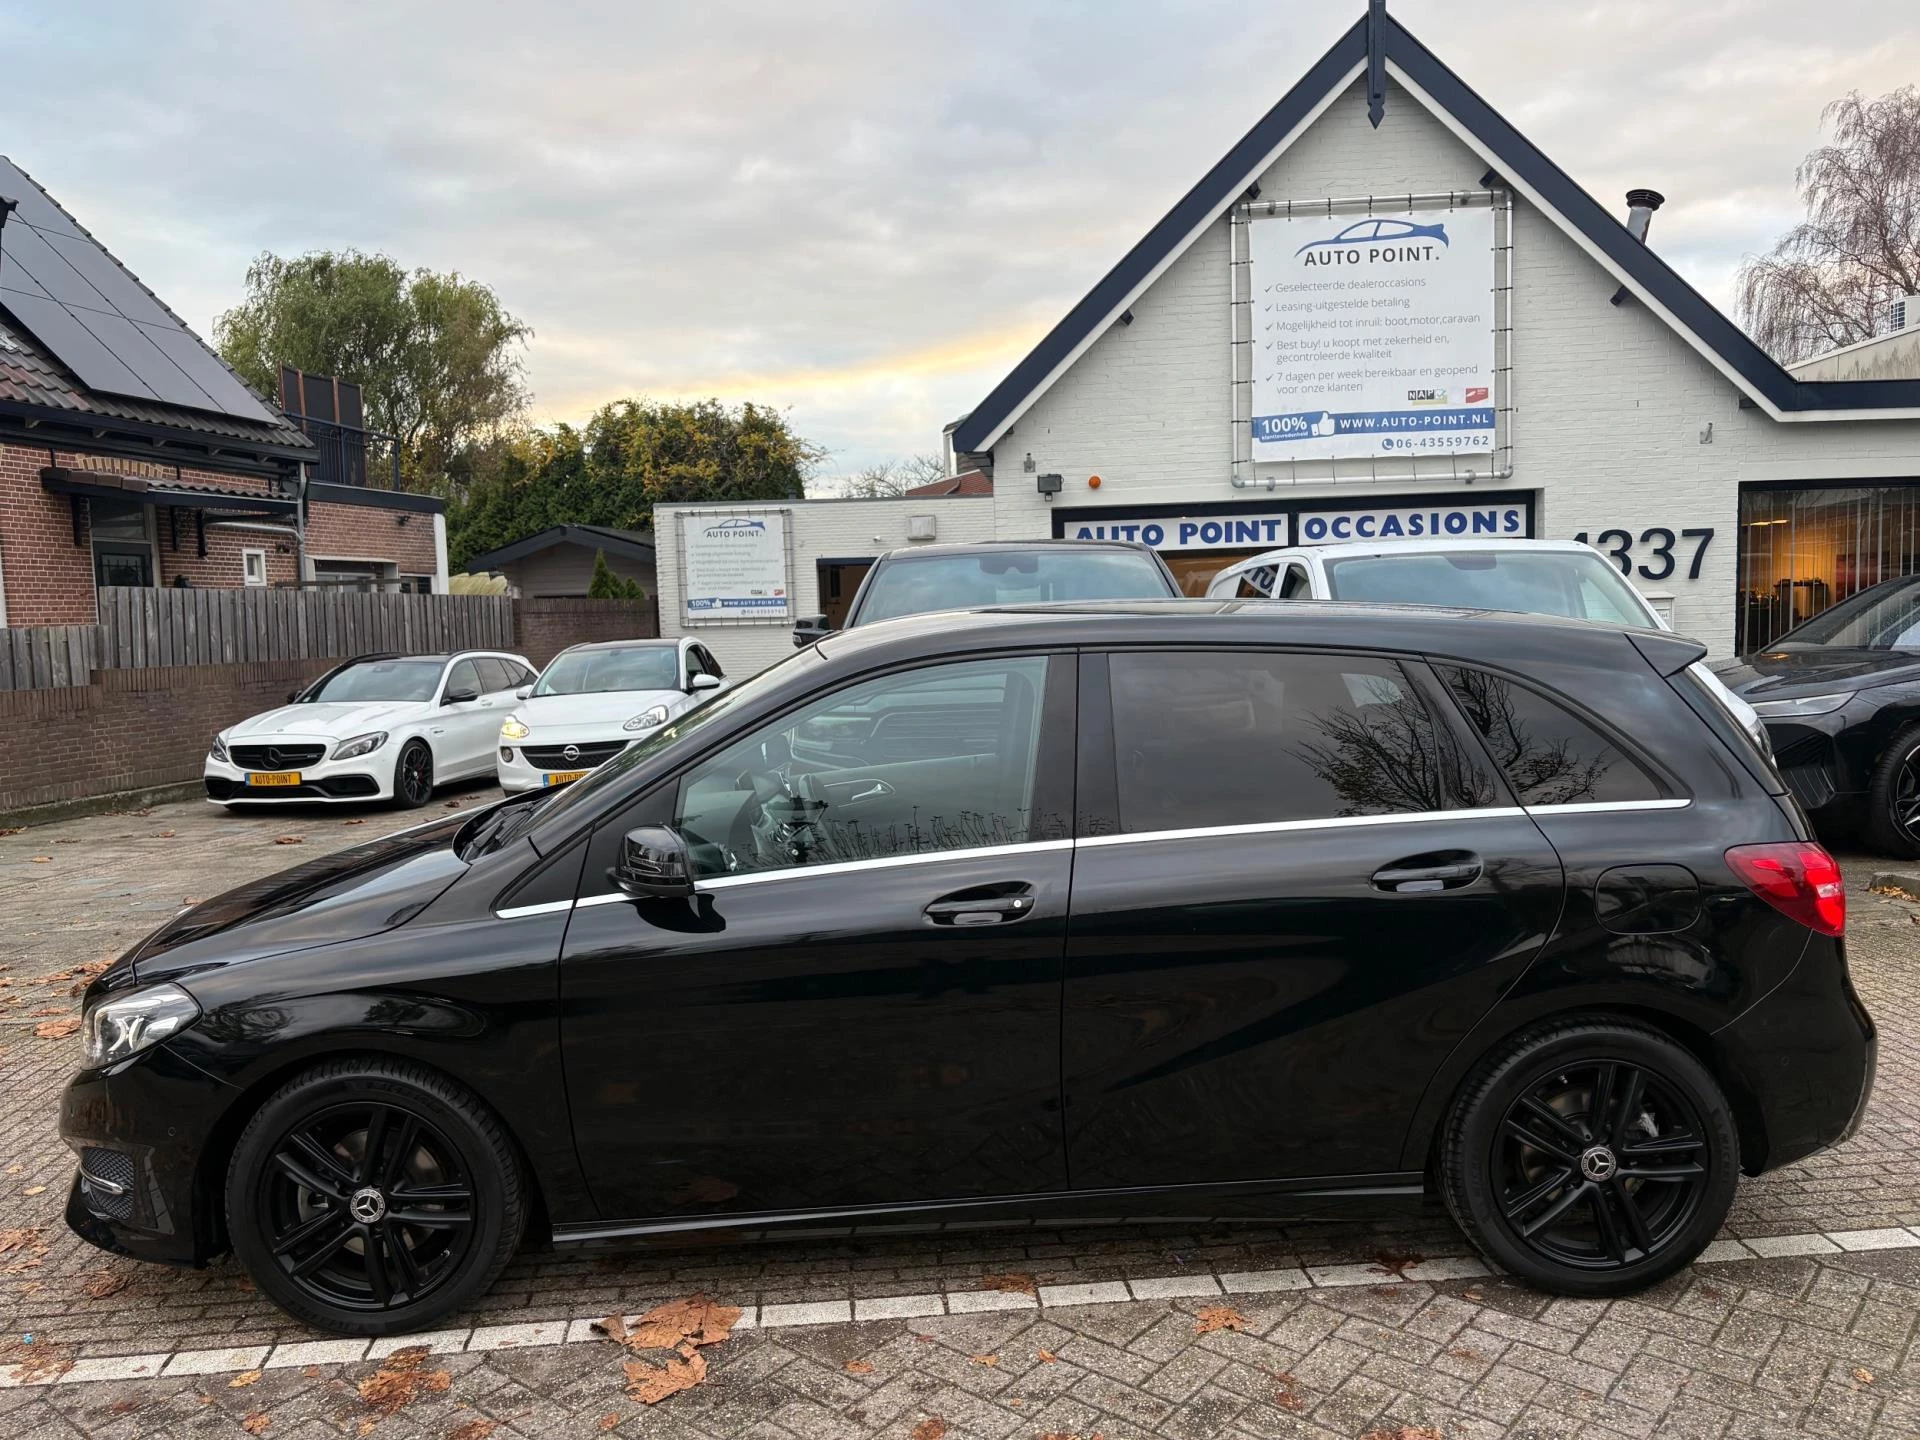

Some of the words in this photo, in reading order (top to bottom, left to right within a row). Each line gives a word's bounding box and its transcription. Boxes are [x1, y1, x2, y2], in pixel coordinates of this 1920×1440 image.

[1304, 250, 1360, 266] AUTO
[1275, 280, 1345, 293] Geselecteerde
[1347, 277, 1426, 290] dealeroccasions
[1371, 297, 1411, 309] betaling
[1276, 317, 1337, 332] Mogelijkheid
[1339, 318, 1353, 329] tot
[1355, 317, 1382, 328] inruil:
[1276, 340, 1299, 350] Best
[1300, 338, 1321, 351] buy!
[1323, 340, 1330, 348] u
[1332, 337, 1360, 349] koopt
[1362, 338, 1383, 346] met
[1384, 334, 1432, 345] zekerheid
[1276, 349, 1351, 366] gecontroleerde
[1353, 348, 1393, 359] kwaliteit
[1277, 372, 1283, 381] 7
[1285, 371, 1316, 384] dagen
[1318, 371, 1335, 382] per
[1336, 368, 1361, 379] week
[1364, 367, 1416, 378] bereikbaar
[1419, 368, 1432, 376] en
[1434, 364, 1478, 378] geopend
[1276, 385, 1299, 395] voor
[1301, 384, 1325, 393] onze
[1327, 381, 1363, 392] klanten
[1261, 416, 1309, 434] 100%
[1339, 413, 1489, 429] WWW.AUTO-POINT.NL
[1396, 435, 1489, 449] 06-43559762
[1179, 519, 1282, 545] POINT
[1304, 509, 1520, 540] OCCASIONS
[706, 530, 730, 538] AUTO
[1573, 527, 1715, 581] 337
[691, 599, 711, 608] 100%
[255, 774, 292, 785] AUTO-POINT
